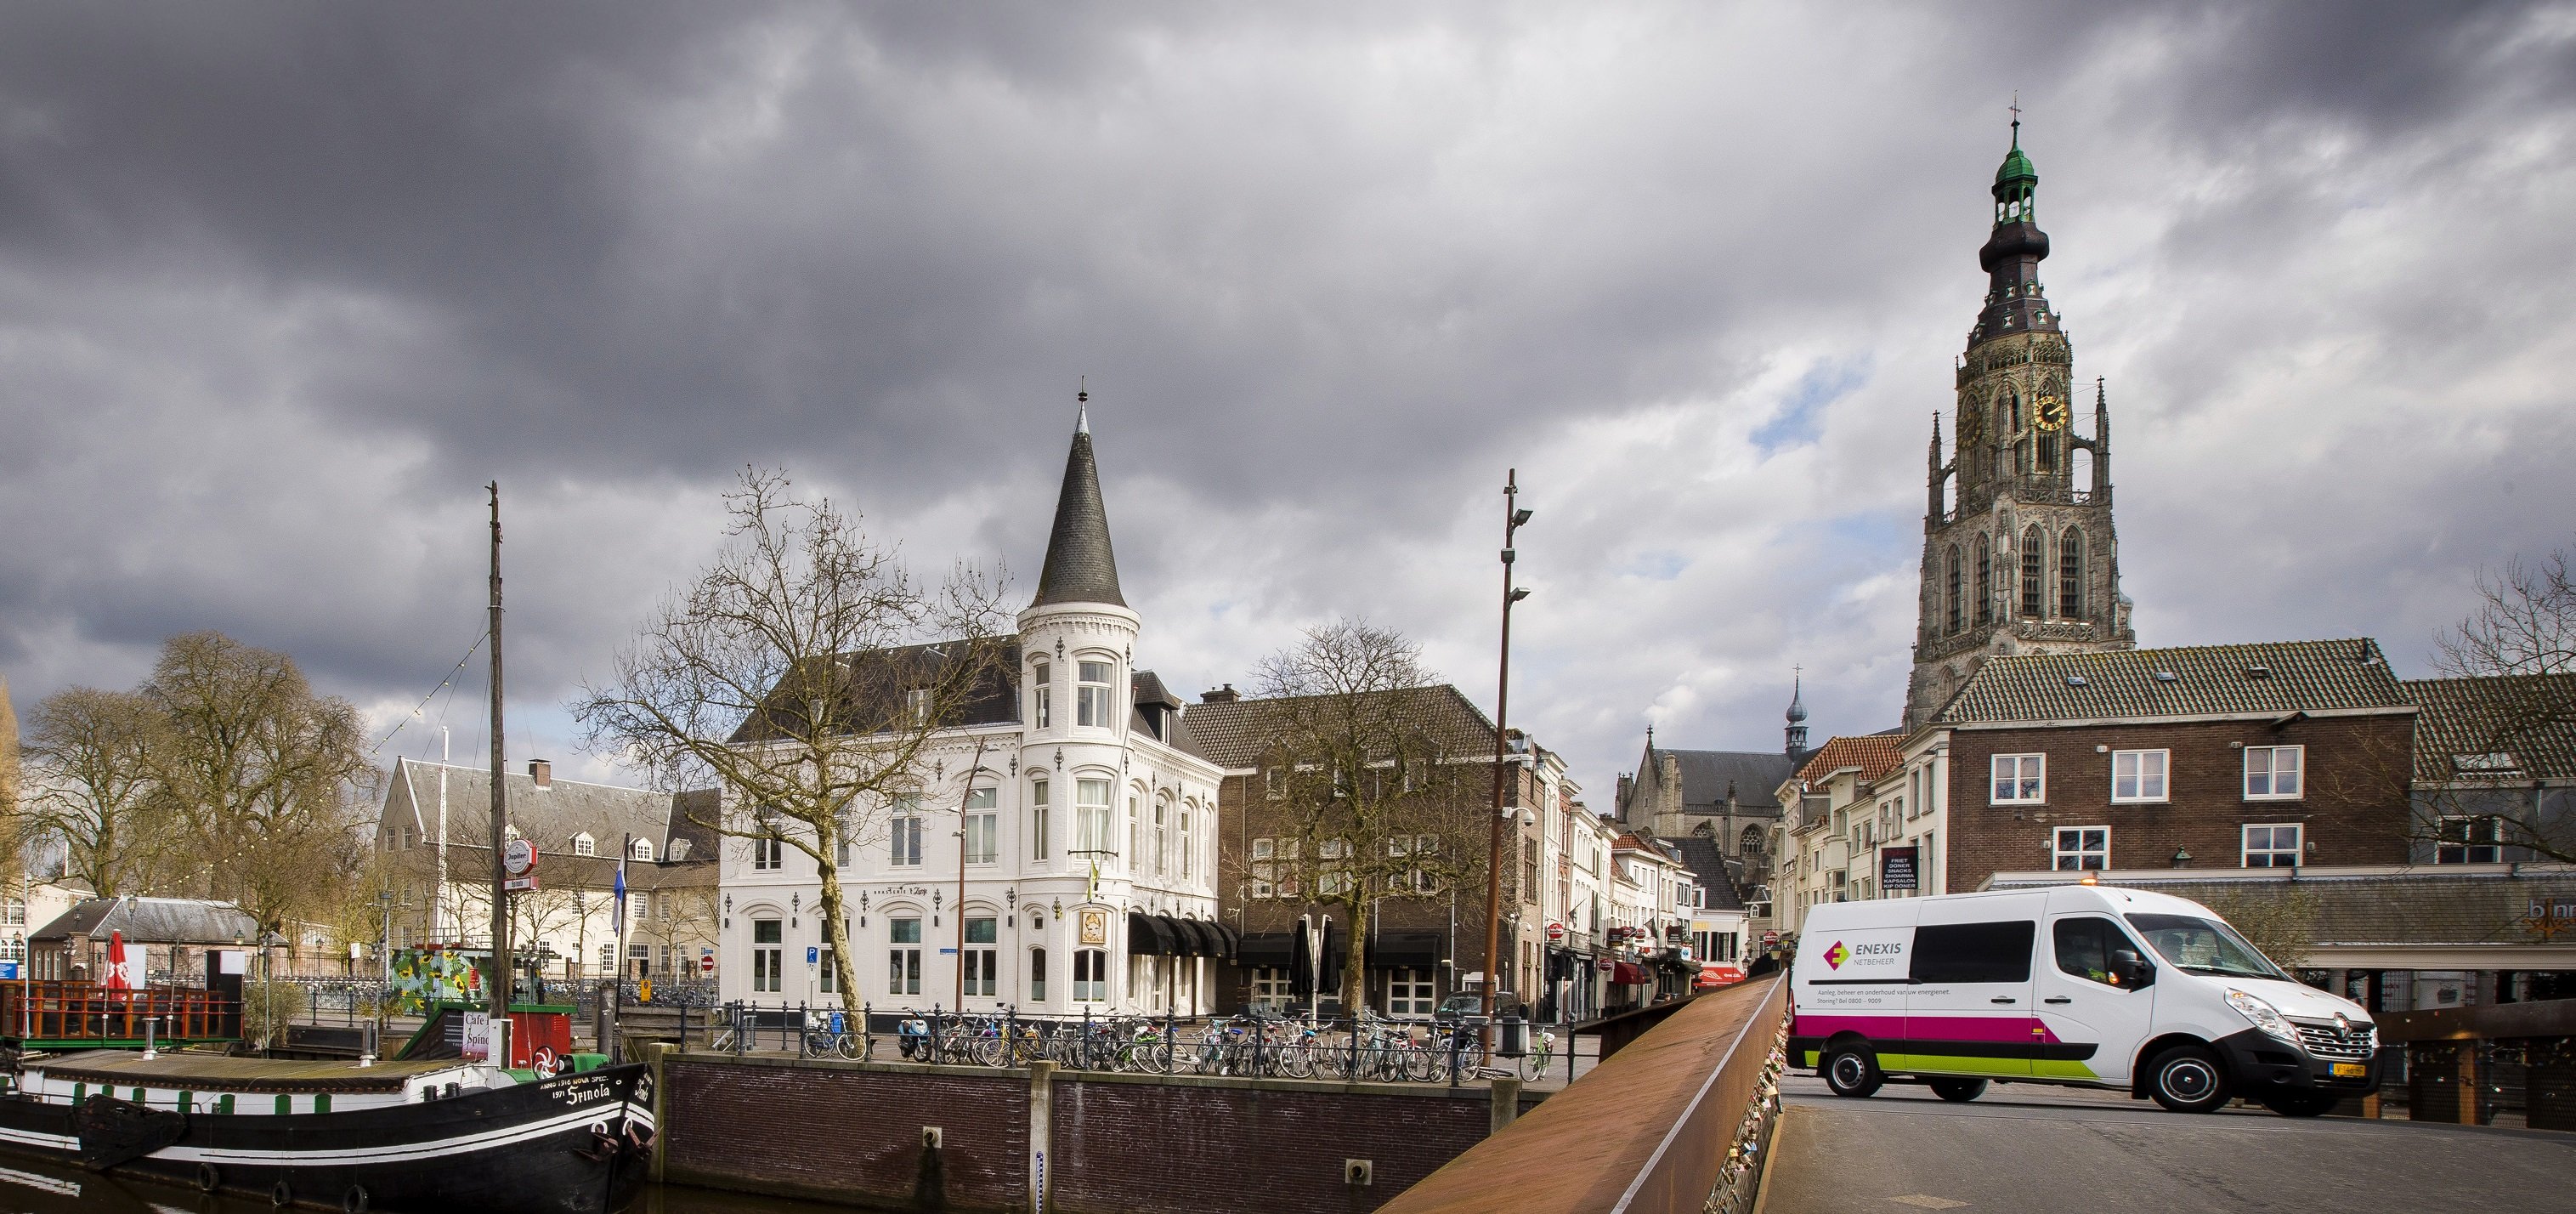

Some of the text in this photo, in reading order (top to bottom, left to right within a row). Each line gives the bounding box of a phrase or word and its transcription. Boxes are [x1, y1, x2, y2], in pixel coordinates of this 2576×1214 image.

[1855, 943, 1901, 955] ENEXIS
[465, 1014, 484, 1025] Cafe
[566, 1084, 609, 1105] Spinola
